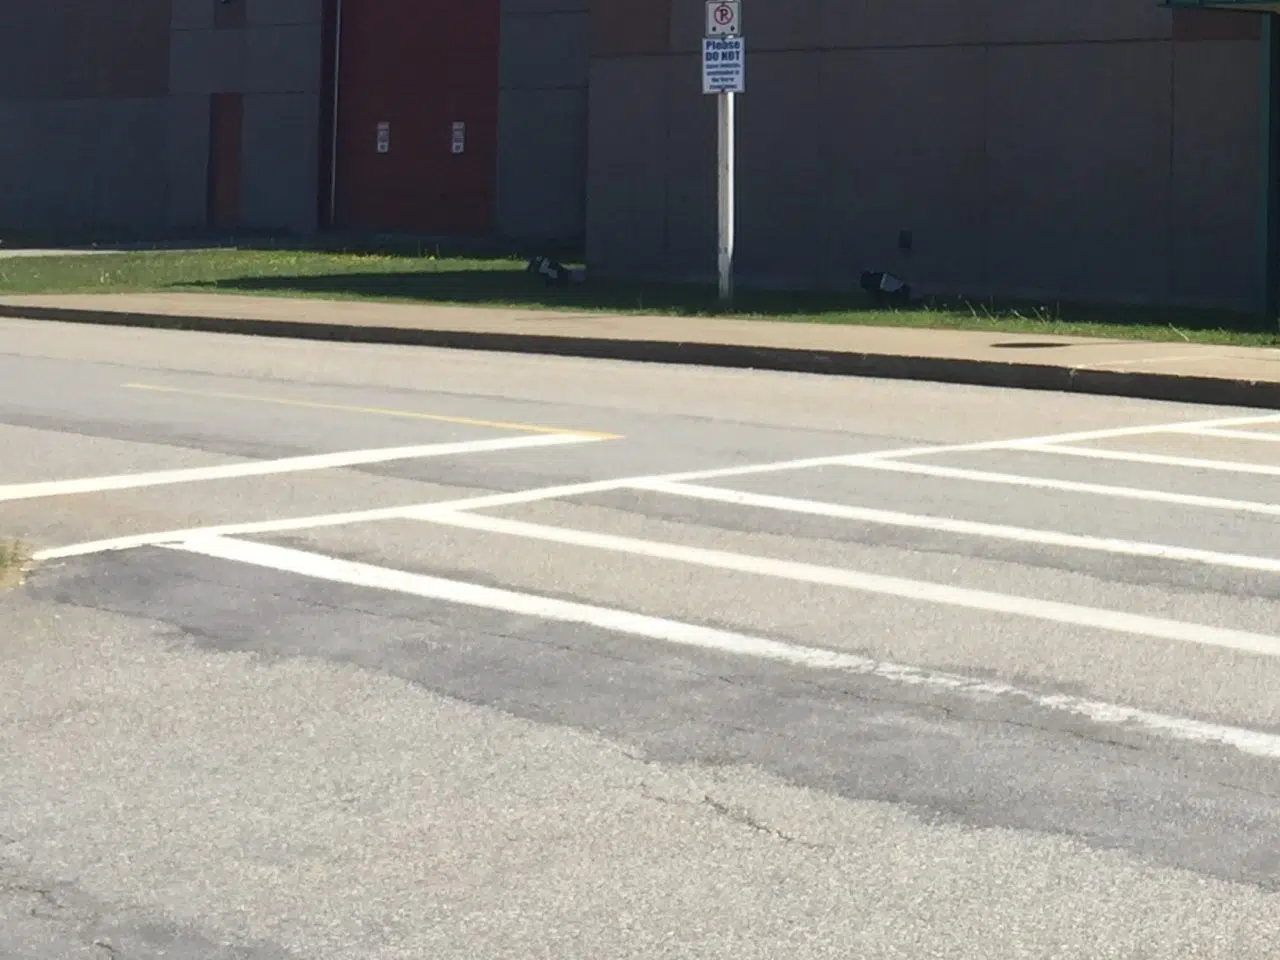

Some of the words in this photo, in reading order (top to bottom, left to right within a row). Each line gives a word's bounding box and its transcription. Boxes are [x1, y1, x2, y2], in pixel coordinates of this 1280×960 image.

[706, 40, 741, 50] Please
[705, 51, 720, 61] DO
[721, 50, 741, 61] NOT
